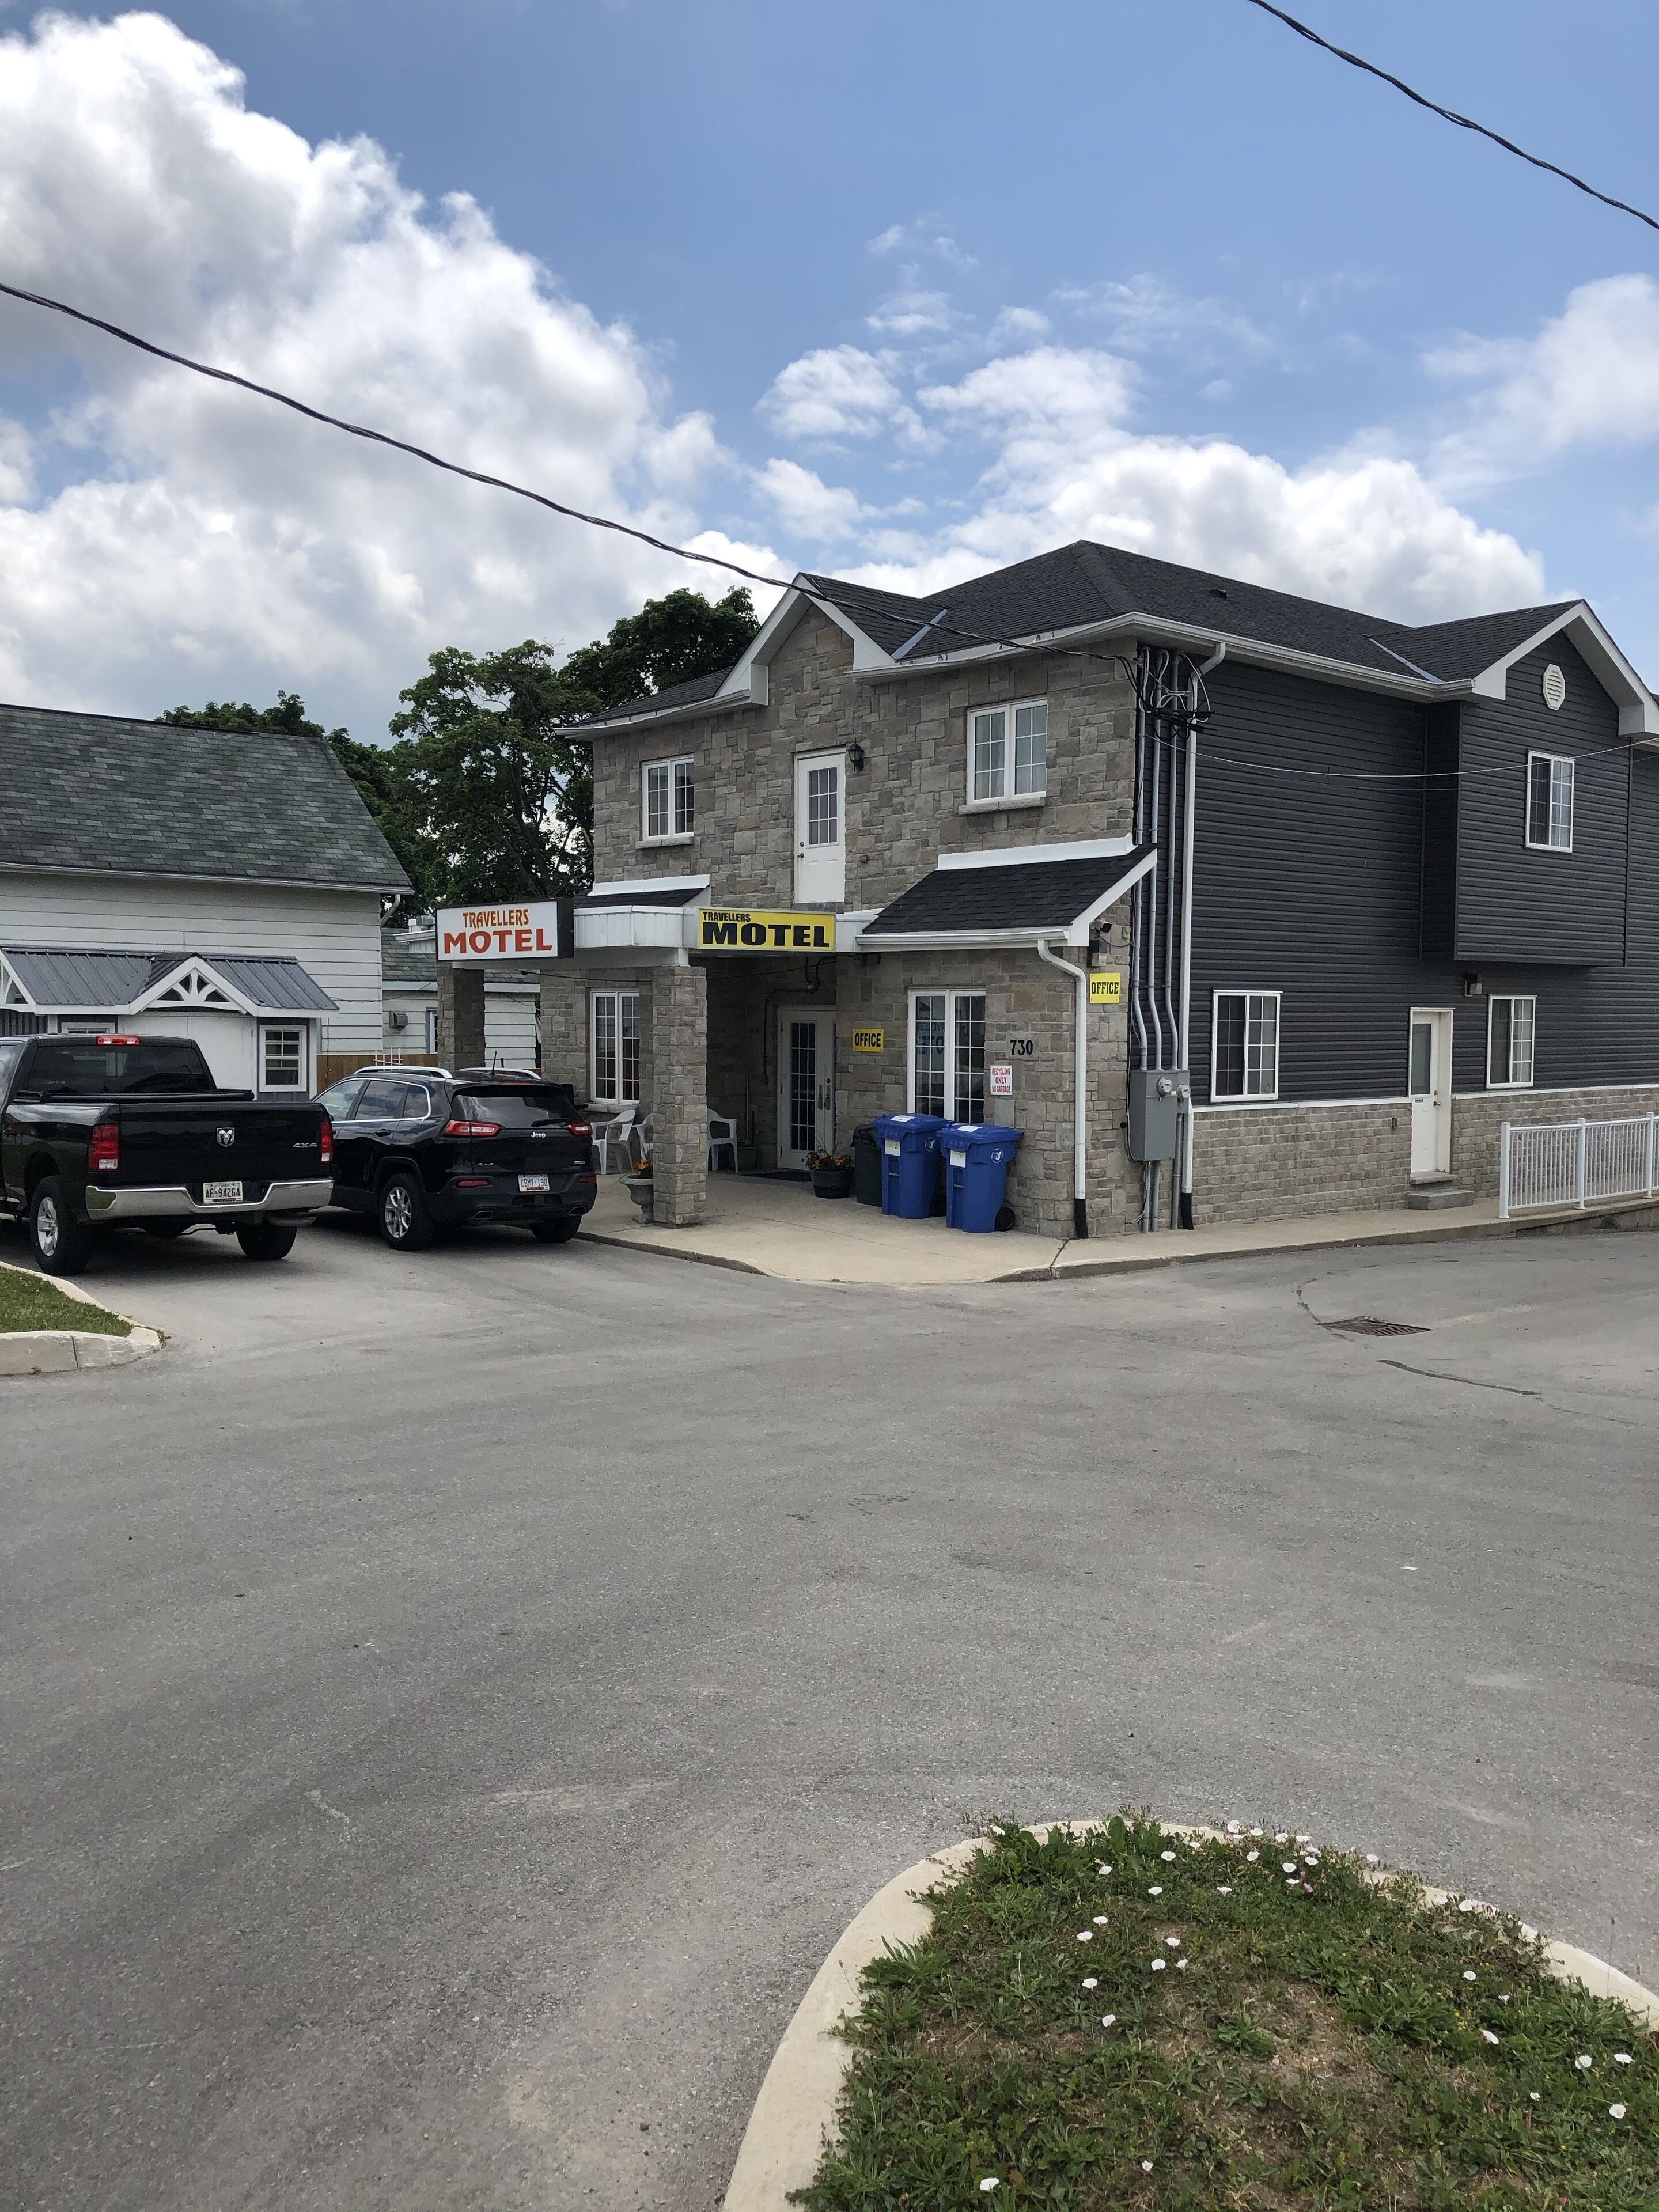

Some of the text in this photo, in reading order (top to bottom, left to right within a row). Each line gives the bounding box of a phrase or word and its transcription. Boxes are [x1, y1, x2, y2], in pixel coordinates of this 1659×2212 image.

[462, 908, 529, 929] TRAVELLERS
[703, 911, 751, 922] TRAVELLERS
[444, 928, 553, 954] MOTEL
[702, 922, 830, 947] MOTEL
[1092, 982, 1119, 994] OFFICE
[855, 1032, 881, 1047] OFFICE
[1010, 1040, 1033, 1055] 730
